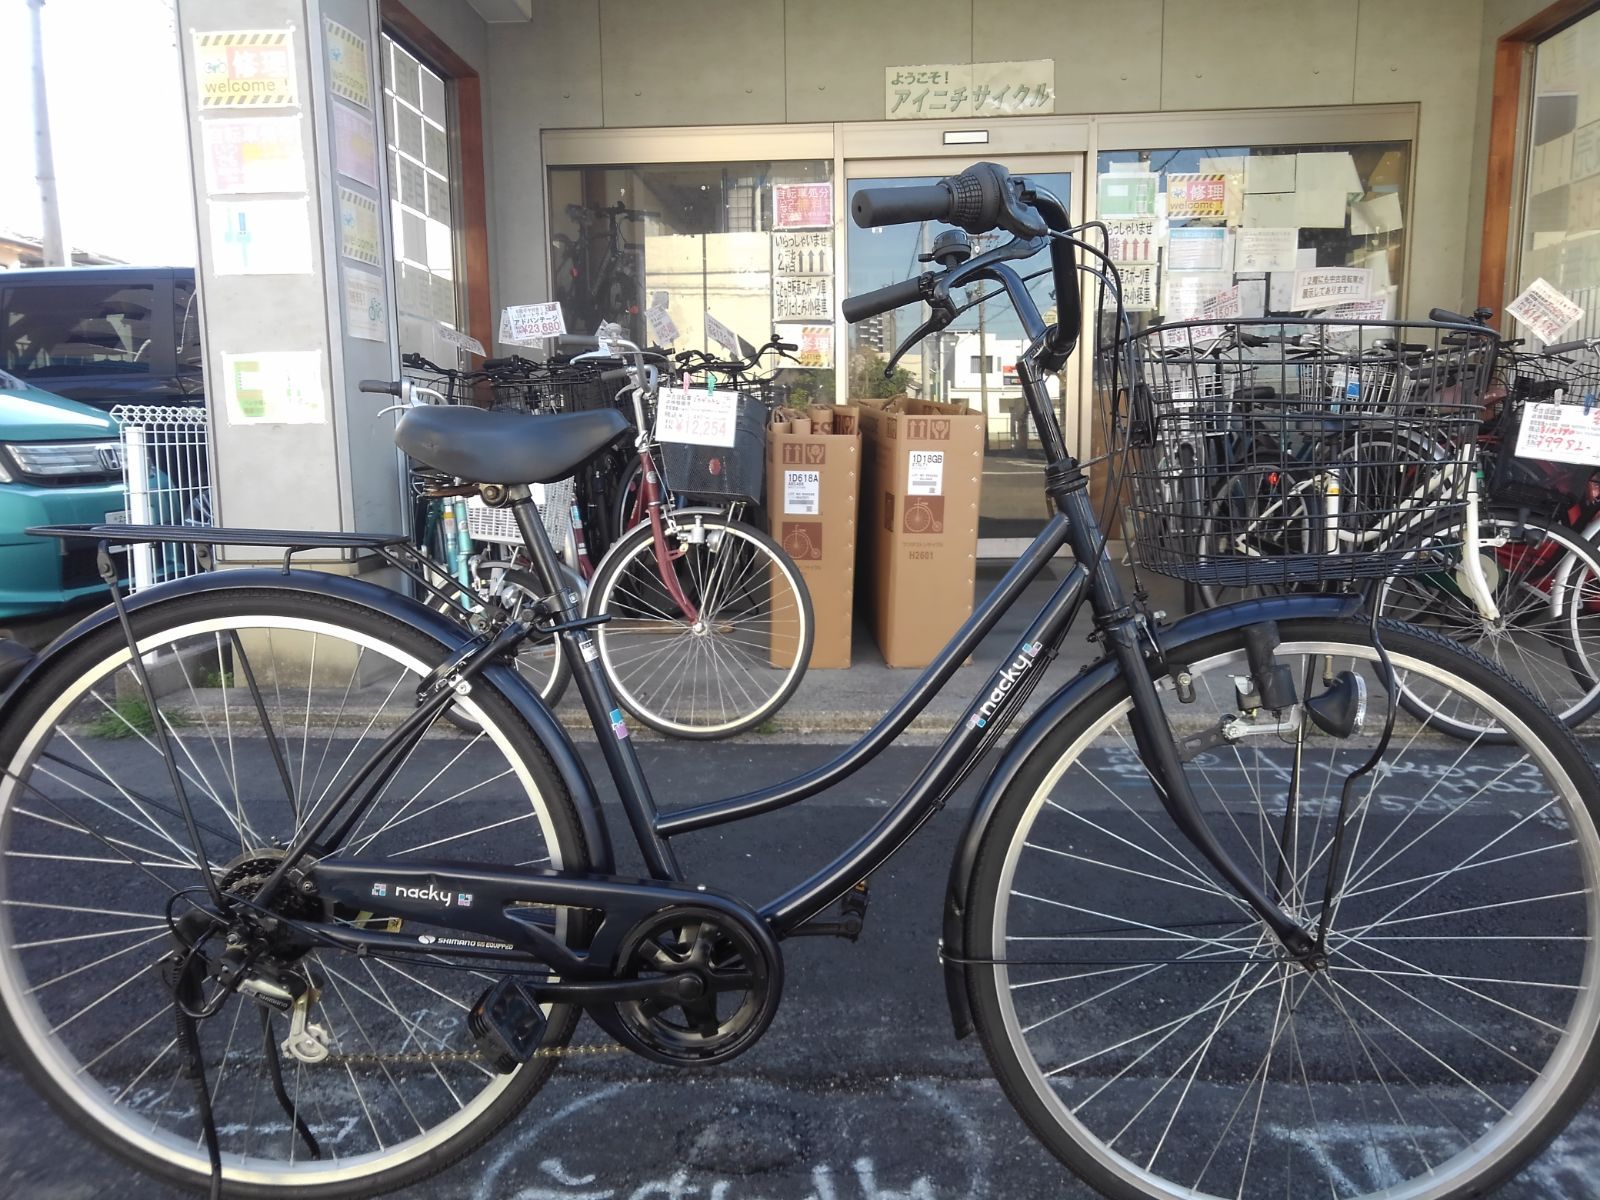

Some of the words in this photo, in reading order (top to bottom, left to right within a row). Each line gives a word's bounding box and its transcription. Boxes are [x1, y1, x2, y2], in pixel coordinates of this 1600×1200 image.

[891, 82, 1050, 113] アイニチサイクル
[1191, 183, 1224, 201] 修理
[775, 233, 828, 248] いらっしゃいませ
[788, 473, 819, 483] 1D618A
[980, 654, 1032, 716] nacky
[395, 884, 452, 907] nacky
[437, 937, 476, 947] SHIMANO
